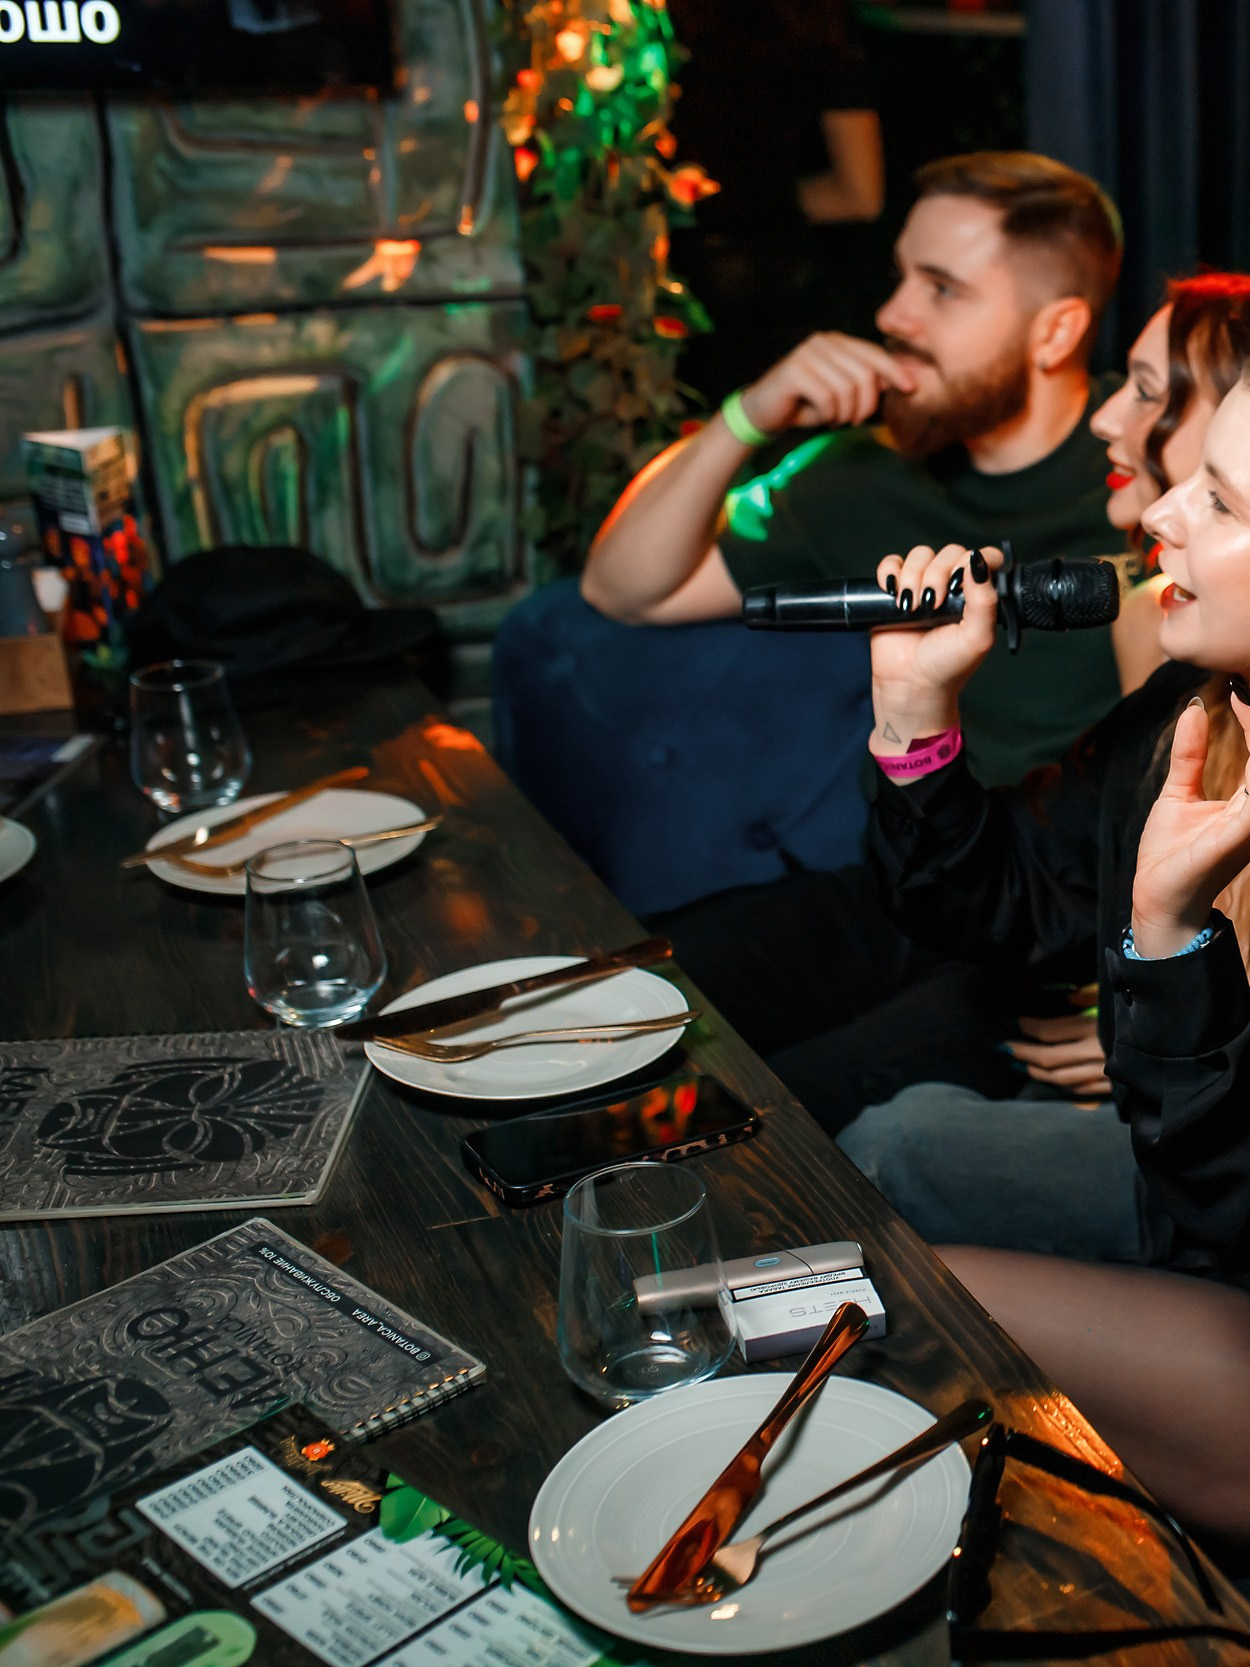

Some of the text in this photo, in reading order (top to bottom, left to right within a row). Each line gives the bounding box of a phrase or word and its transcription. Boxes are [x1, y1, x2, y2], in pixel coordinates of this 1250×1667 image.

[259, 1247, 341, 1302] ОБСЛУЖИВАНИЕ 10%
[759, 1286, 785, 1294] ТАБАКА
[352, 1308, 421, 1355] BOTANICA_AREA
